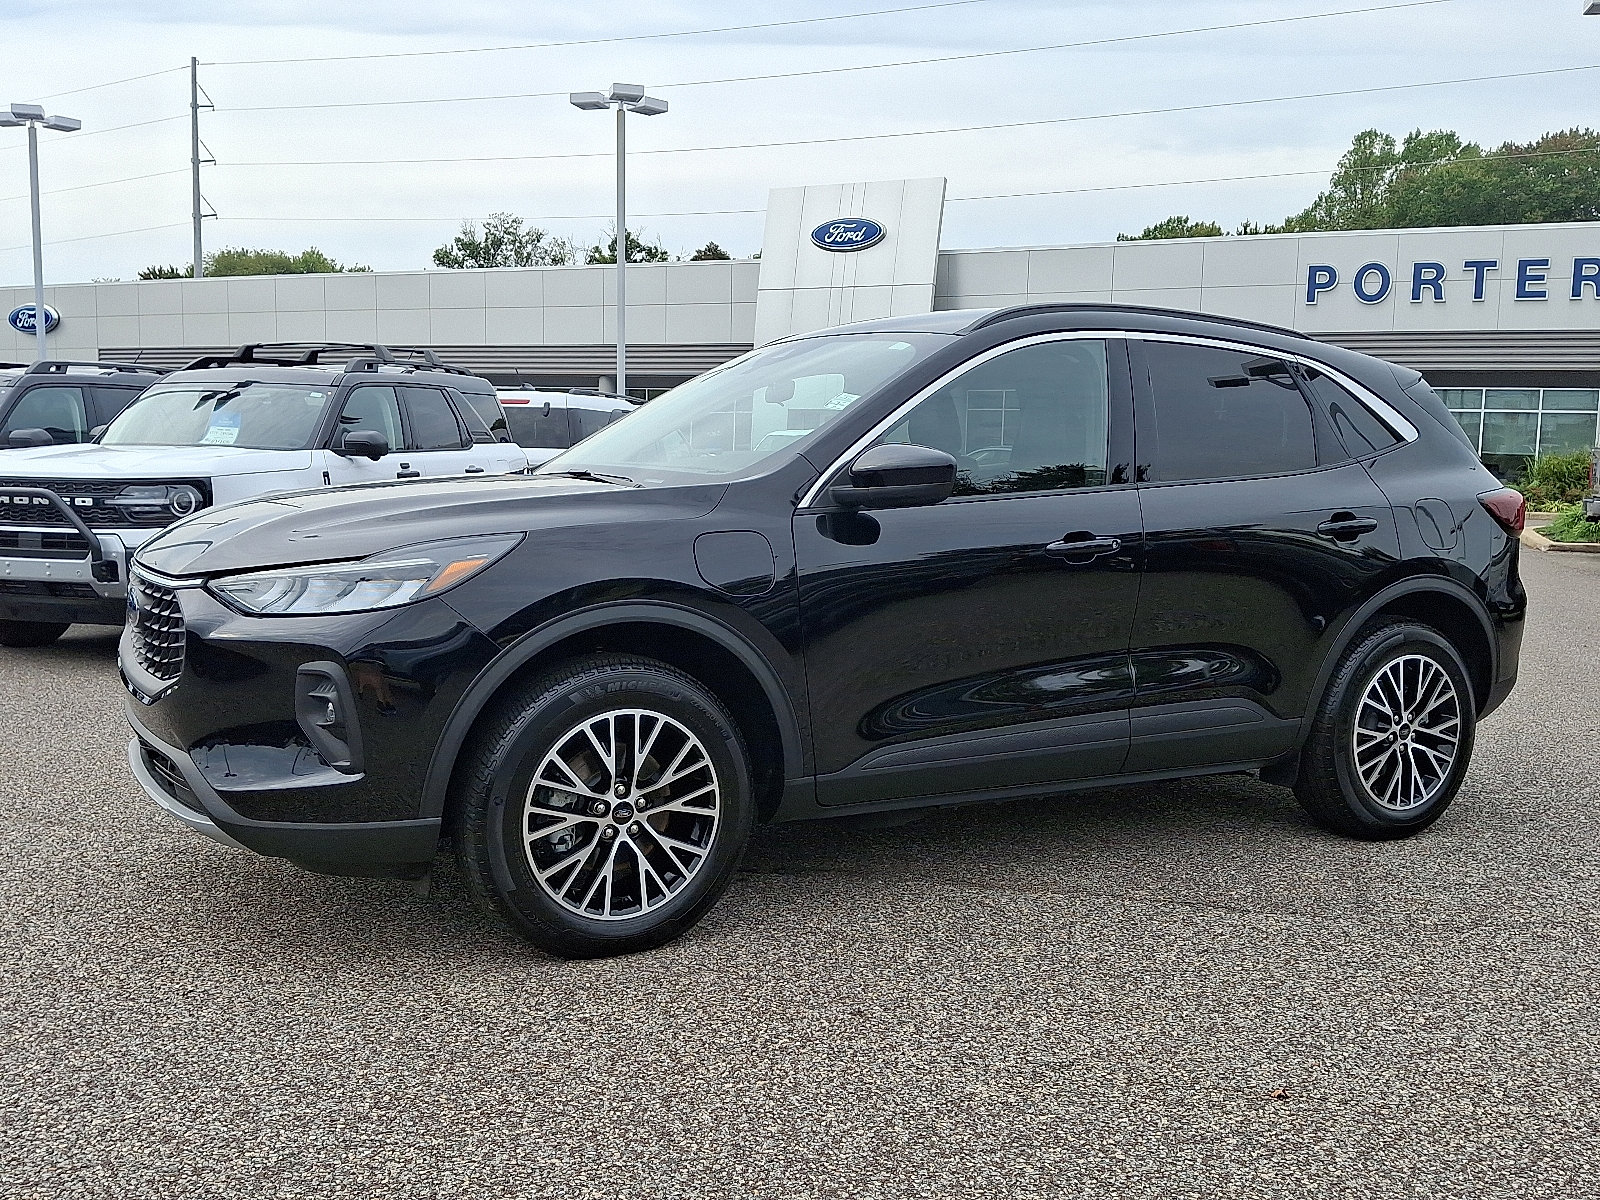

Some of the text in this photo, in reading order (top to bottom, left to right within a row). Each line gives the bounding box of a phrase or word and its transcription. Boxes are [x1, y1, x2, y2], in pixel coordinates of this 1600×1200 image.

[824, 222, 868, 243] Ford
[1305, 256, 1600, 305] PORTER
[16, 309, 38, 328] For
